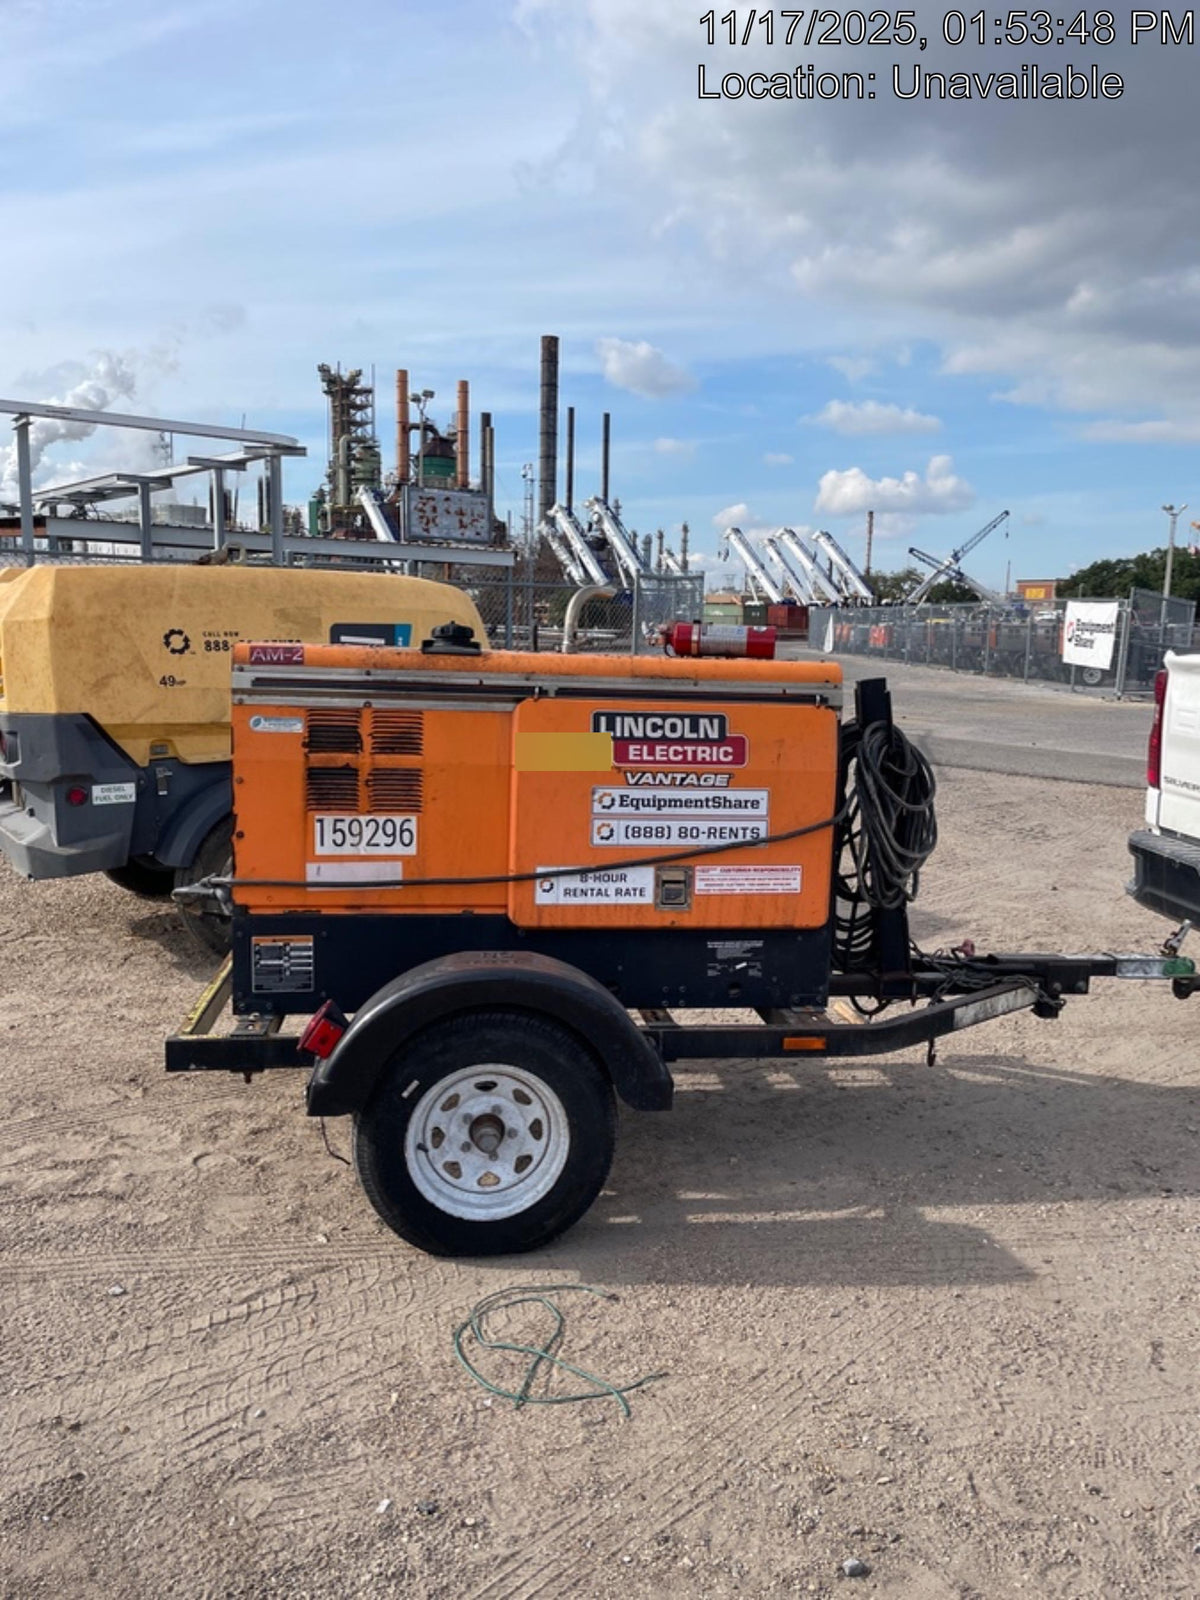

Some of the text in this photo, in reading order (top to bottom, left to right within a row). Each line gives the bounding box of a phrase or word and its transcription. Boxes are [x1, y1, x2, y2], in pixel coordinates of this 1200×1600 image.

[250, 648, 303, 661] AM-2
[600, 716, 720, 739] LINCOLN
[628, 745, 734, 761] ELECTRIC
[624, 772, 732, 787] VANTAGE
[618, 794, 760, 811] EquipmentShare
[316, 818, 415, 847] 159296
[625, 825, 761, 840] (888) 80-RENTS
[580, 873, 628, 883] 8-HOUR
[563, 887, 647, 897] RENTAL RATE
